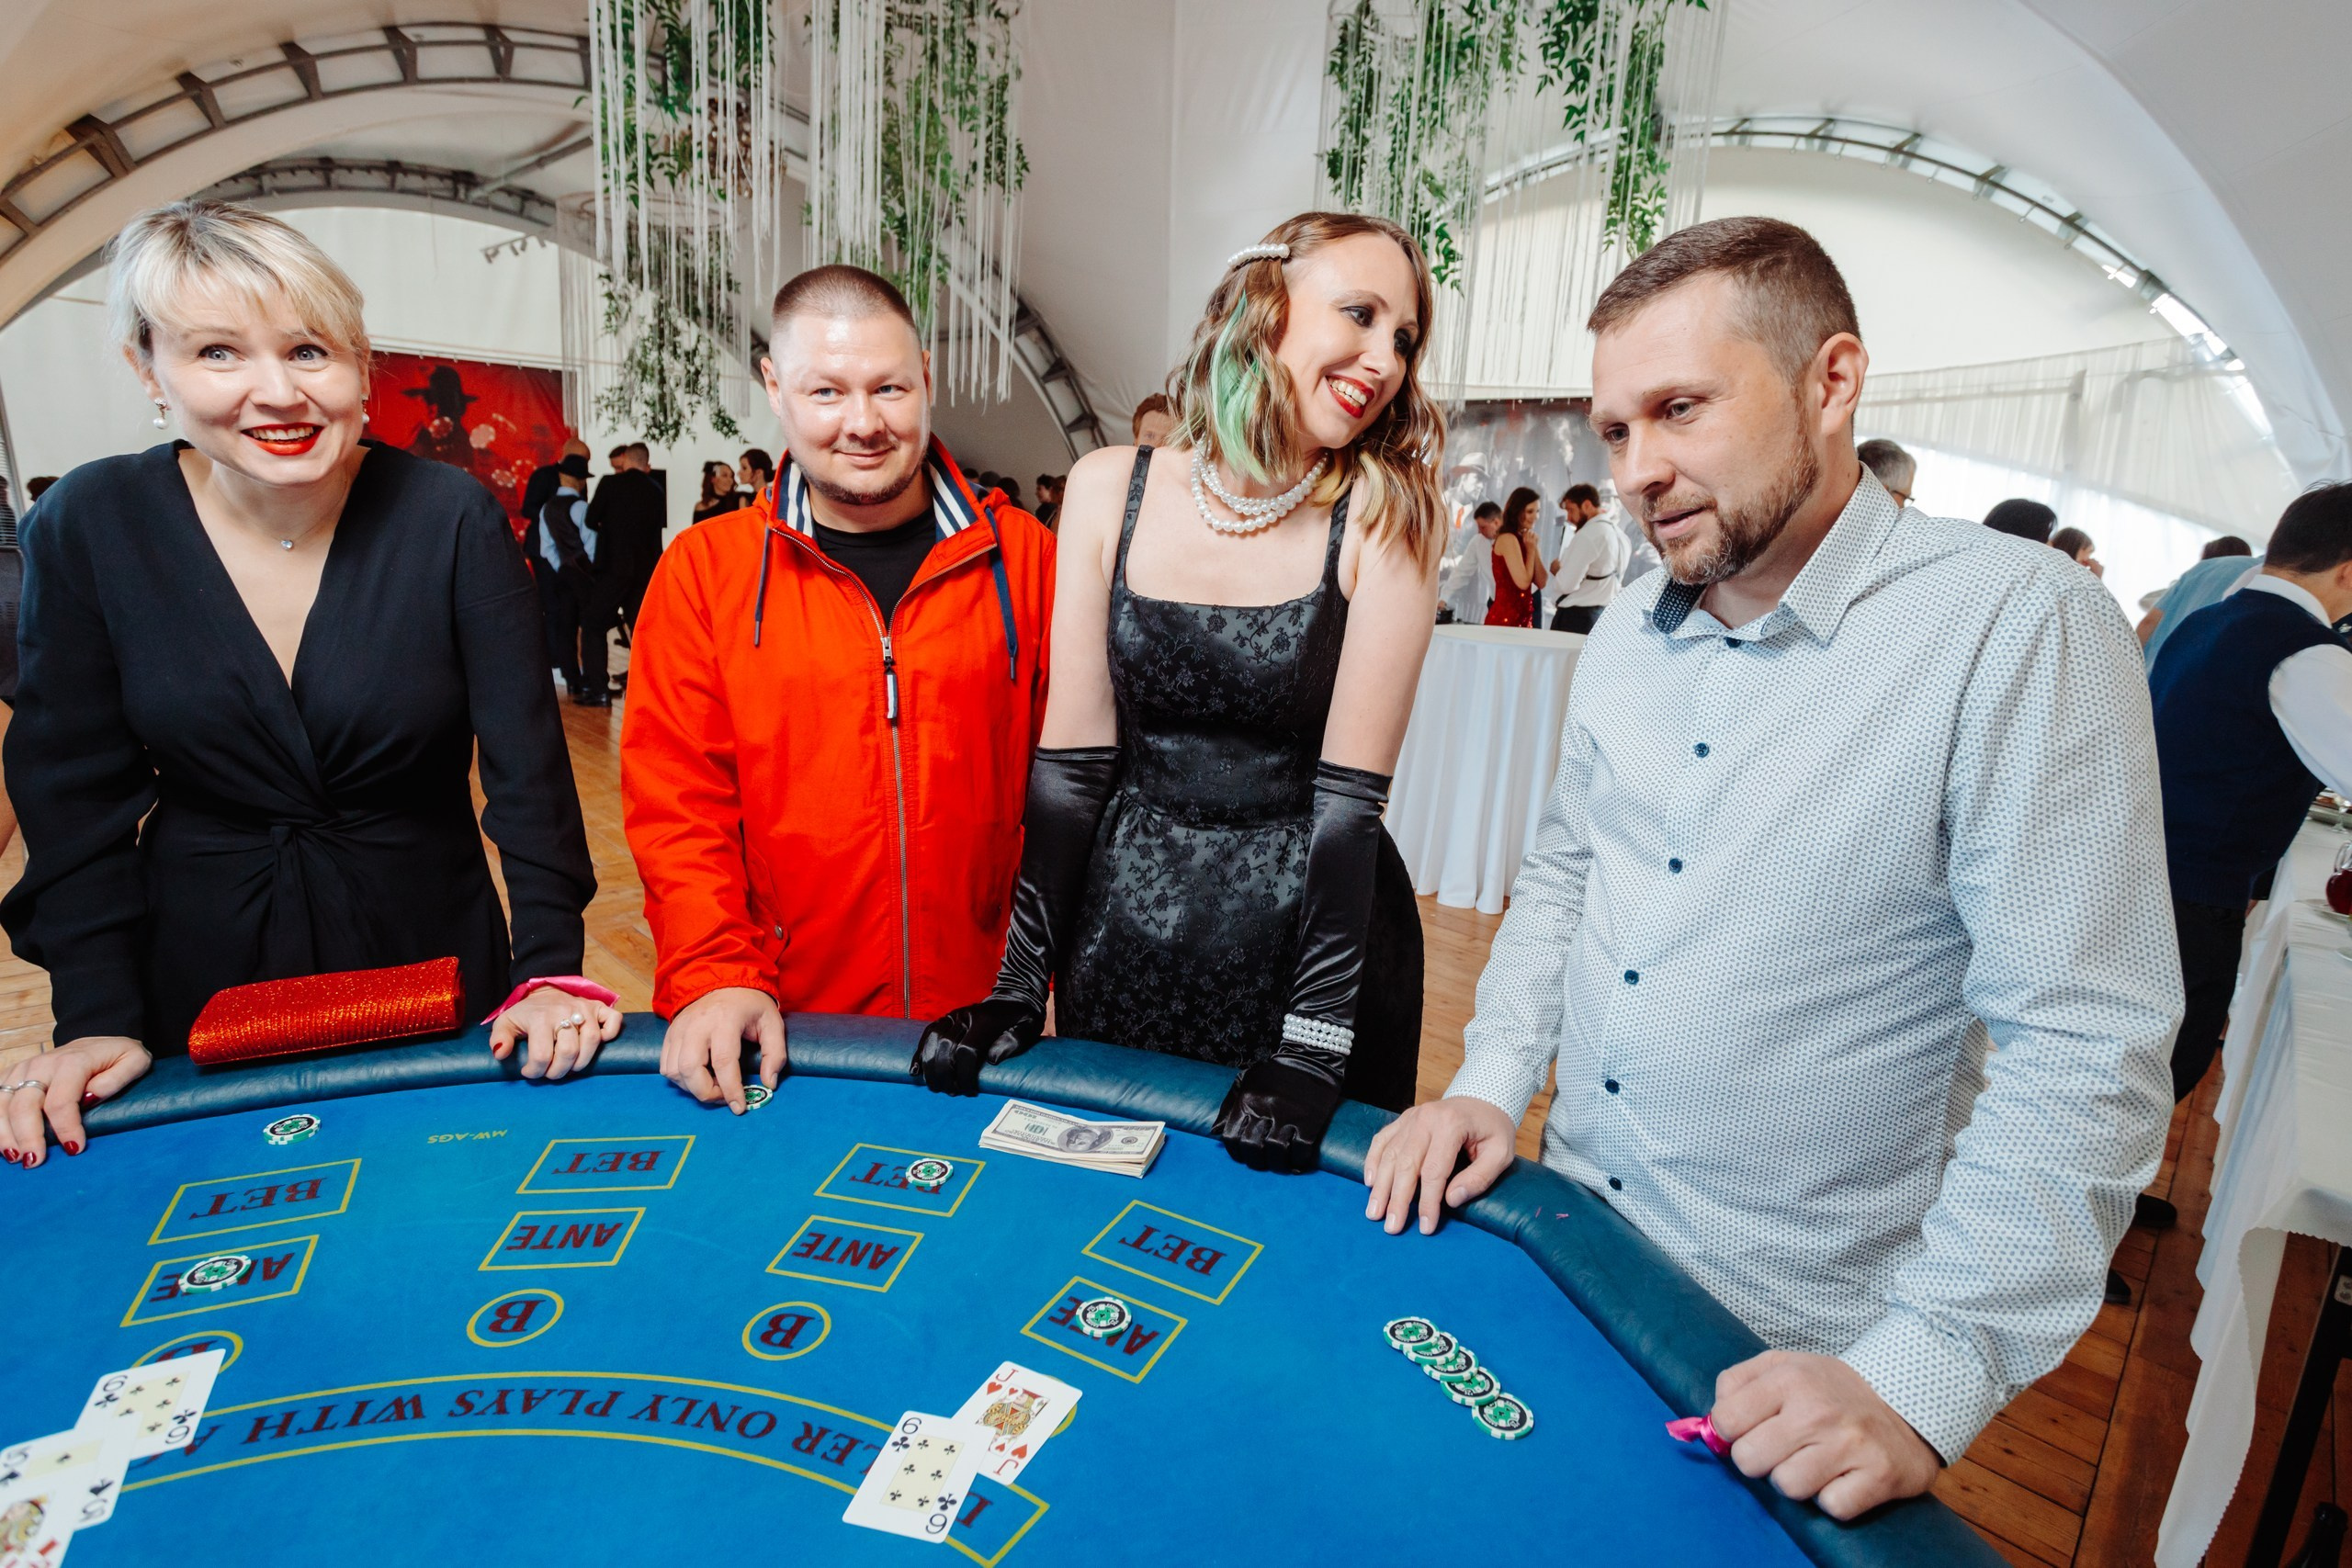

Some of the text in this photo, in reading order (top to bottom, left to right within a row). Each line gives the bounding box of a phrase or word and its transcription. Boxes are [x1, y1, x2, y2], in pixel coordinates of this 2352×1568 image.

[426, 1129, 508, 1144] MW-AGS
[551, 1150, 666, 1175] BET
[848, 1161, 944, 1195] ET
[188, 1177, 328, 1221] BET
[504, 1222, 624, 1250] ANTE
[791, 1232, 900, 1271] ANTE
[1118, 1224, 1227, 1277] BET
[488, 1299, 546, 1333] B
[760, 1313, 816, 1349] B
[240, 1393, 427, 1446] WITH
[447, 1388, 625, 1417] PLAYS
[628, 1393, 777, 1440] ONLY
[901, 1416, 922, 1435] 6
[925, 1513, 947, 1535] 6
